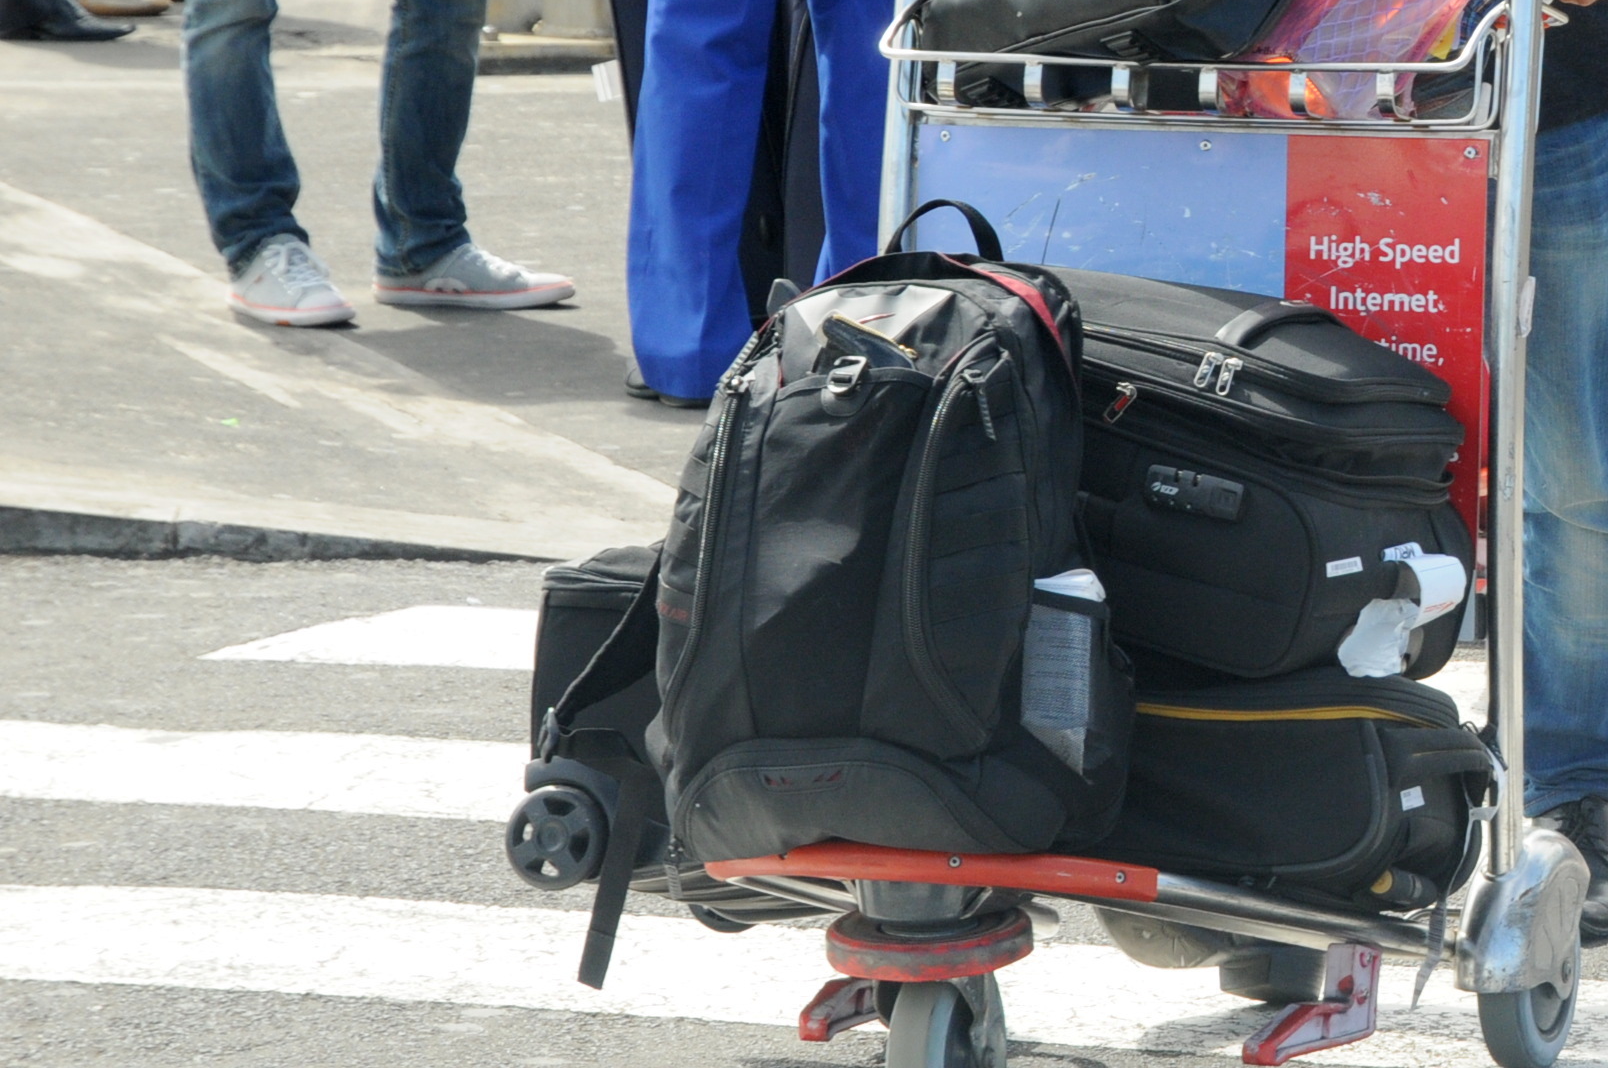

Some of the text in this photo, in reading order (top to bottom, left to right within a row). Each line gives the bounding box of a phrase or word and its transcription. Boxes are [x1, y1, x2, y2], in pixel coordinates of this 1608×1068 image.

[1310, 235, 1460, 269] High Speed
[1330, 285, 1438, 313] Internet
